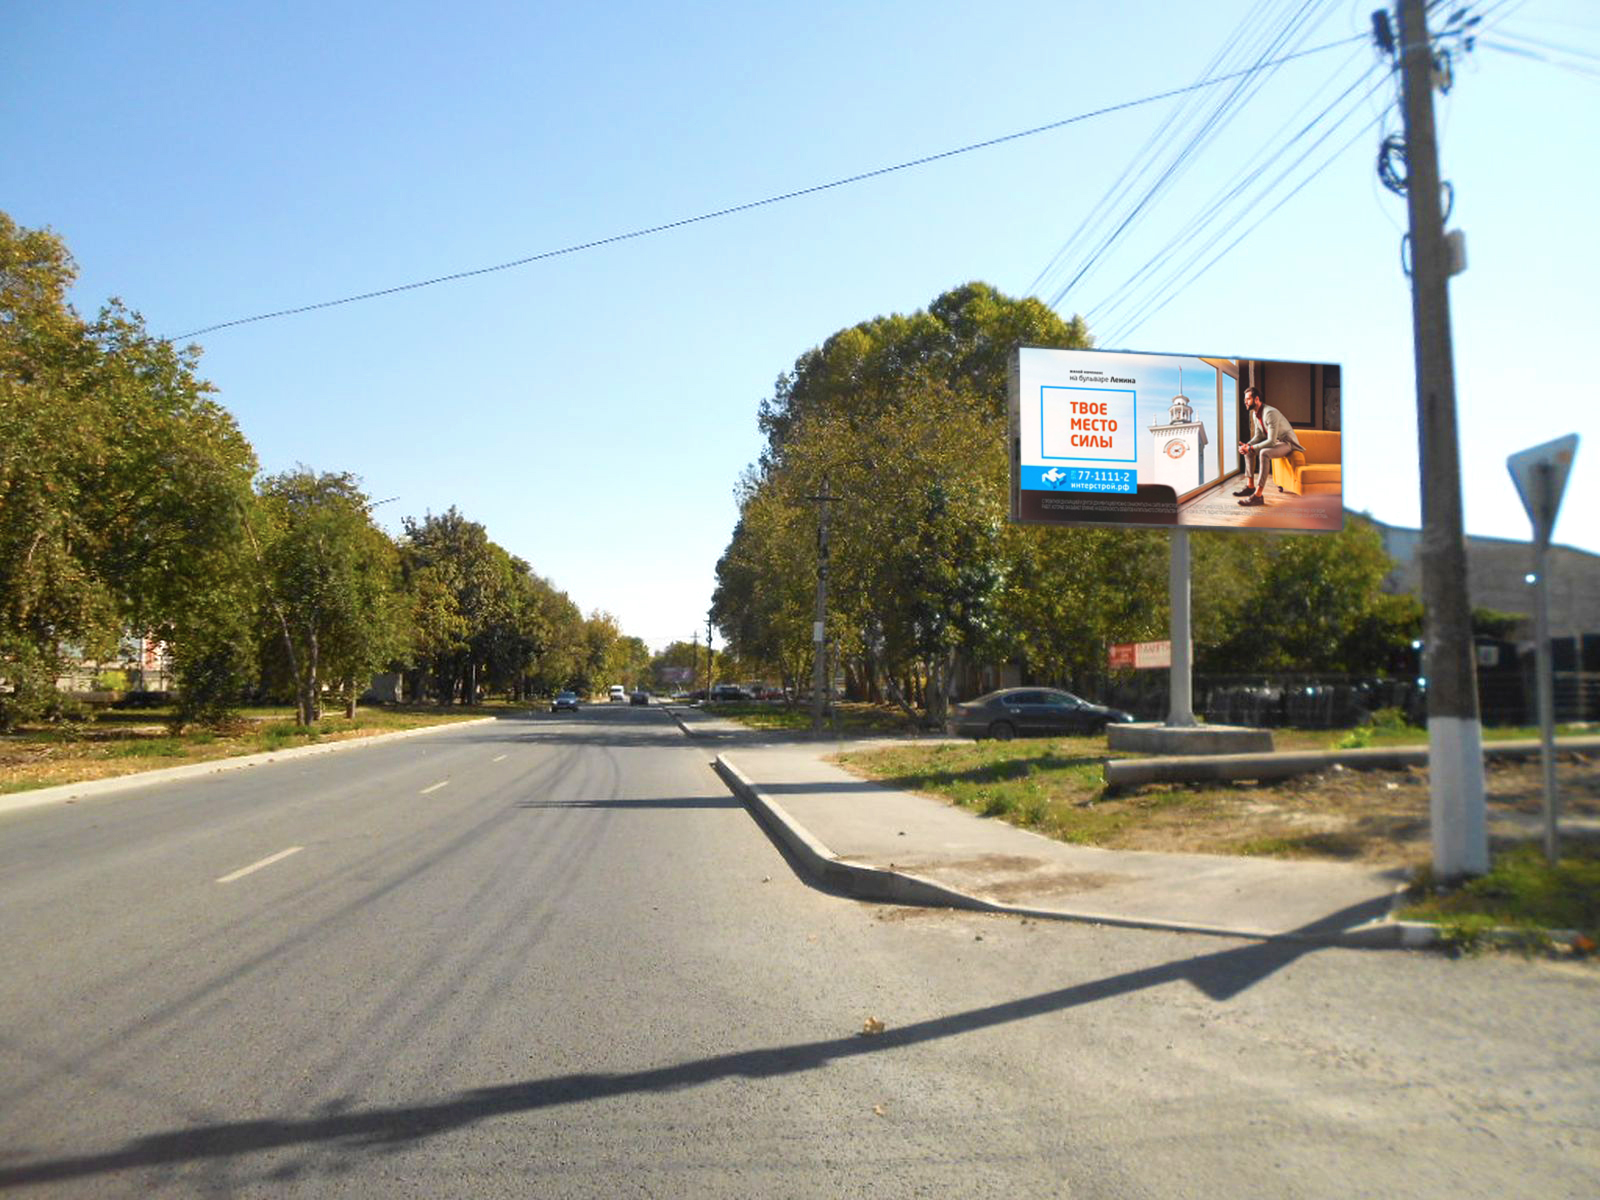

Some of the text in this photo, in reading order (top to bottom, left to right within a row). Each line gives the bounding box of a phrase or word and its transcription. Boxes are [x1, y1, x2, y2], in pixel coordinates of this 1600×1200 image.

[1079, 375, 1109, 383] бульваре
[1110, 376, 1136, 384] Ленина
[1070, 401, 1107, 415] ТВОЕ
[1071, 417, 1117, 432] МЕСТО
[1071, 434, 1112, 448] СИЛЫ
[1078, 470, 1130, 482] 77-1111-2
[1071, 482, 1130, 492] интерстрой.рф
